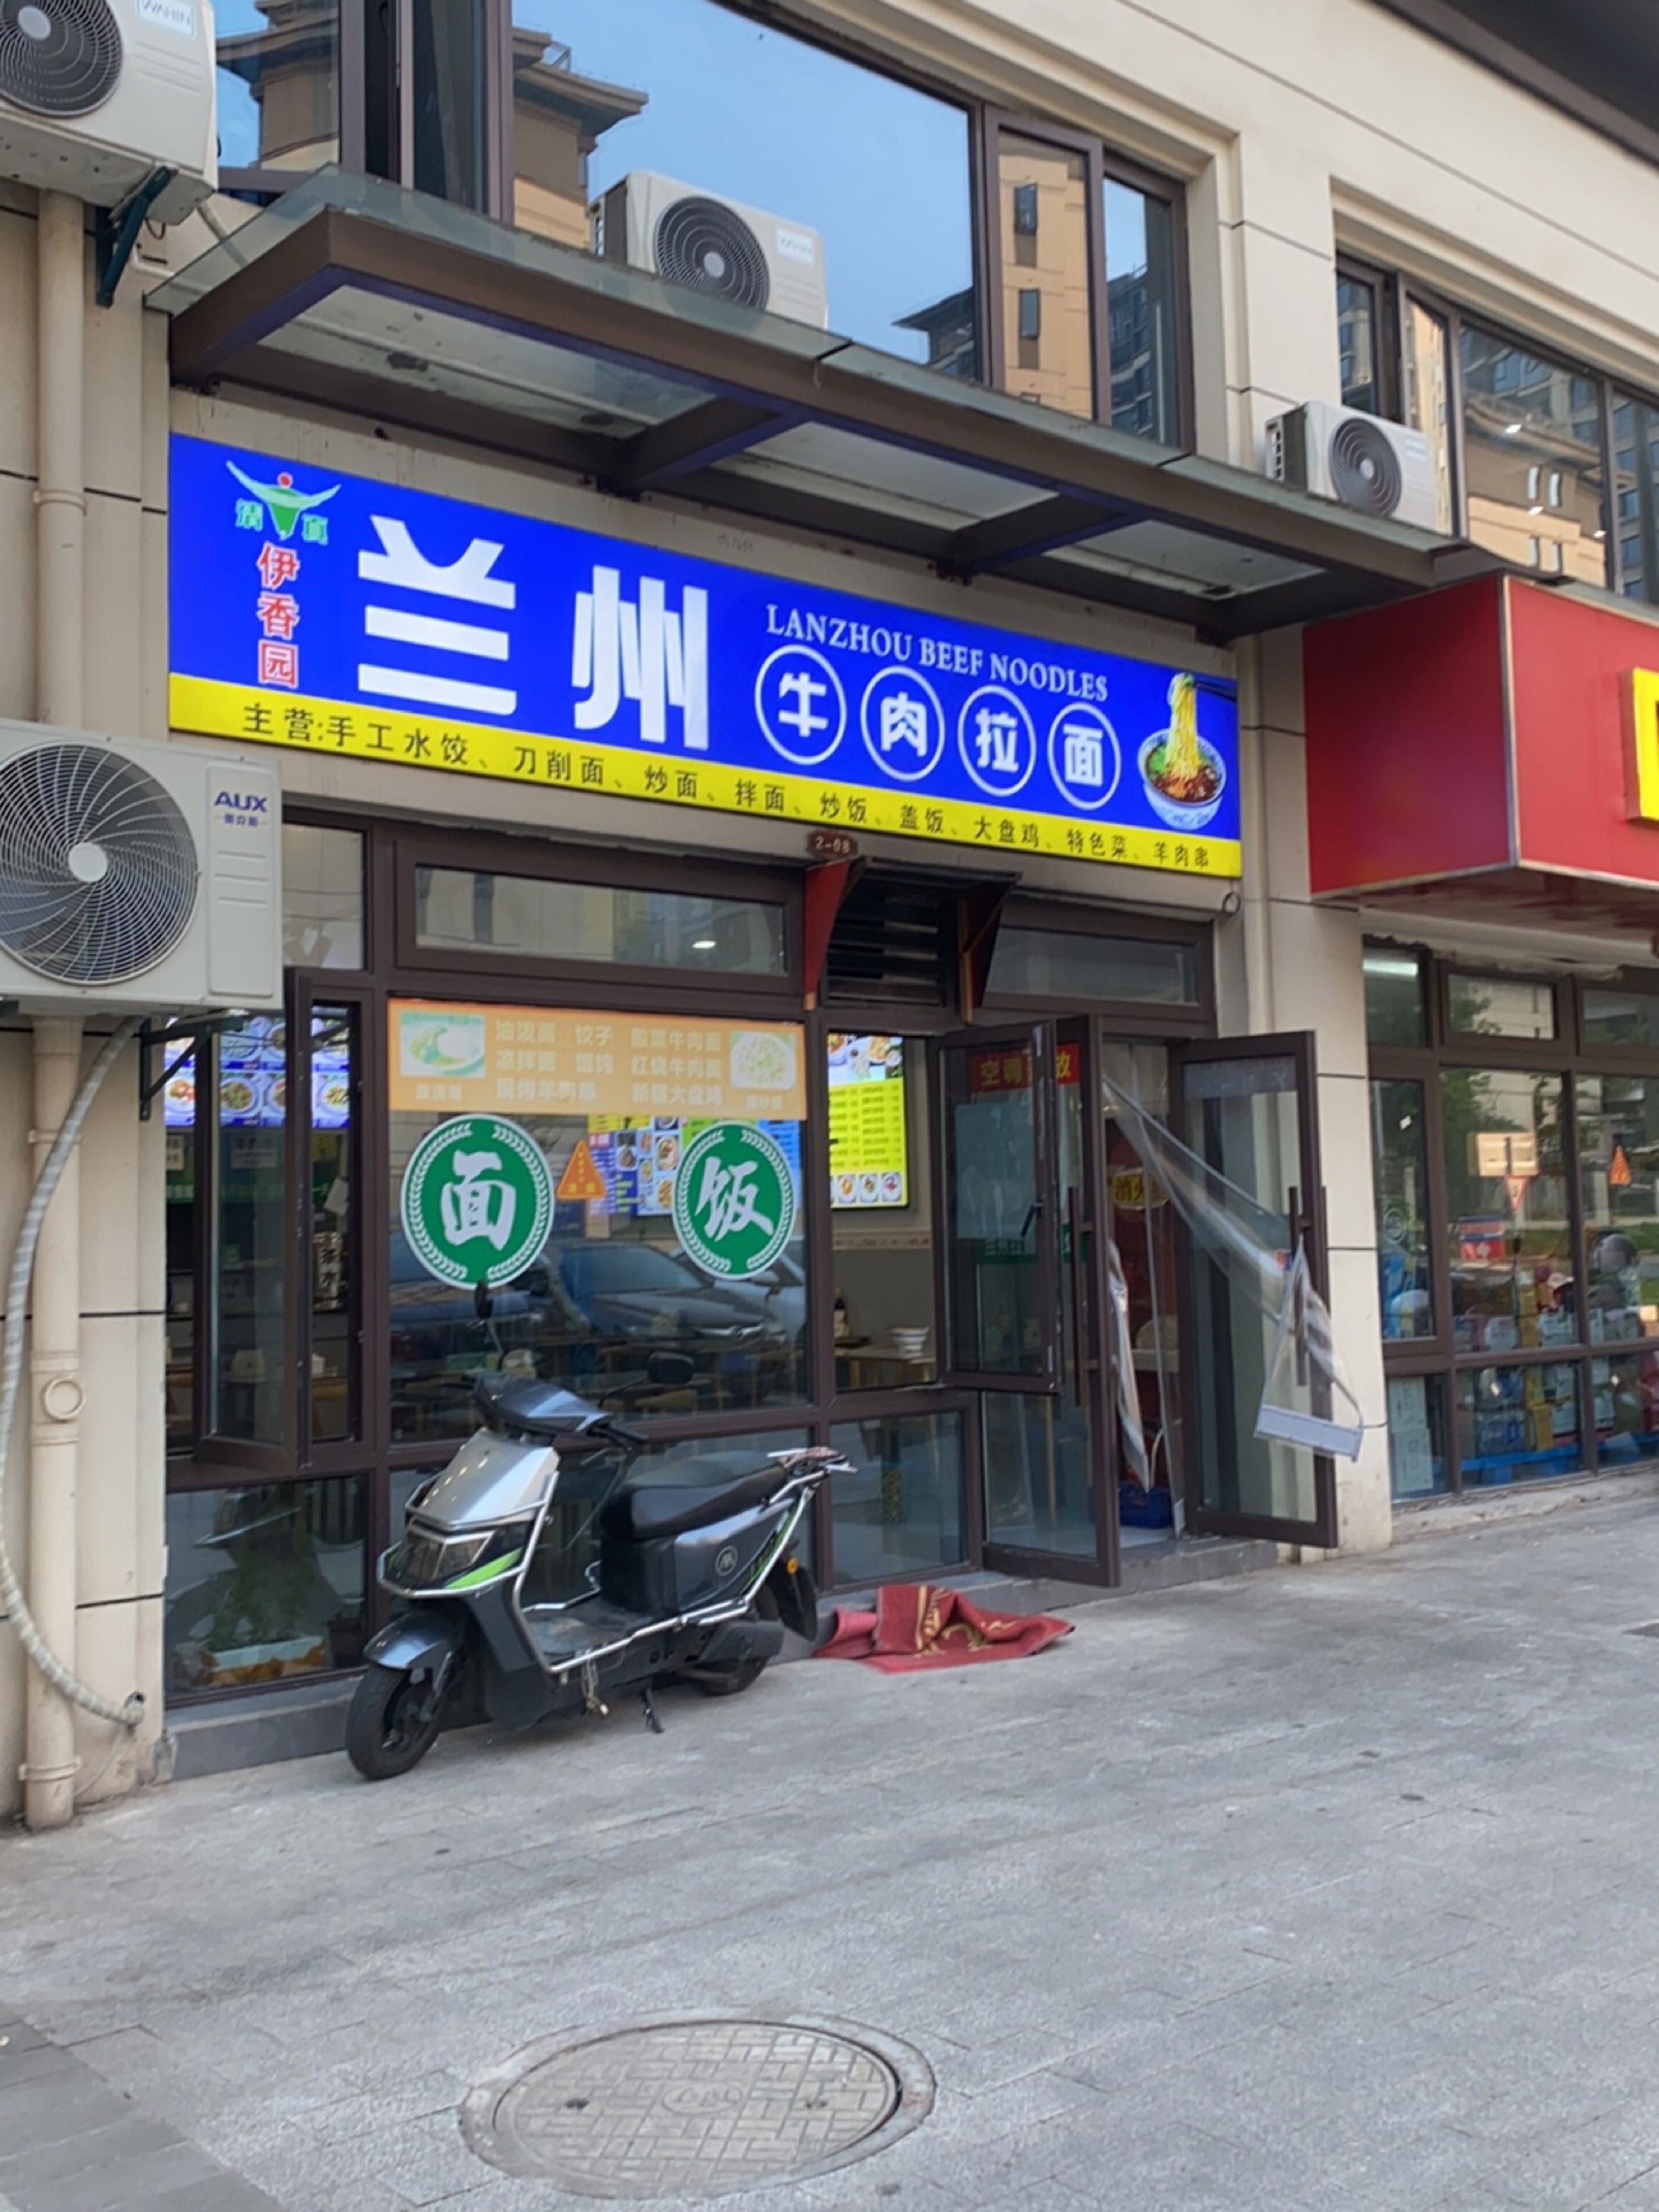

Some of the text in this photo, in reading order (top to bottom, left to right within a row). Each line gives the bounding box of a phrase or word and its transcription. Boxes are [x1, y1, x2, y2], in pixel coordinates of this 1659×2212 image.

[257, 541, 300, 689] 伊香园
[358, 514, 709, 751] 兰州
[766, 605, 1109, 701] LANZHOU BEEF NOODLES
[778, 671, 1104, 788] 牛肉拉面
[214, 791, 268, 812] AUX
[441, 1150, 517, 1250] 面
[695, 1157, 773, 1242] 饭
